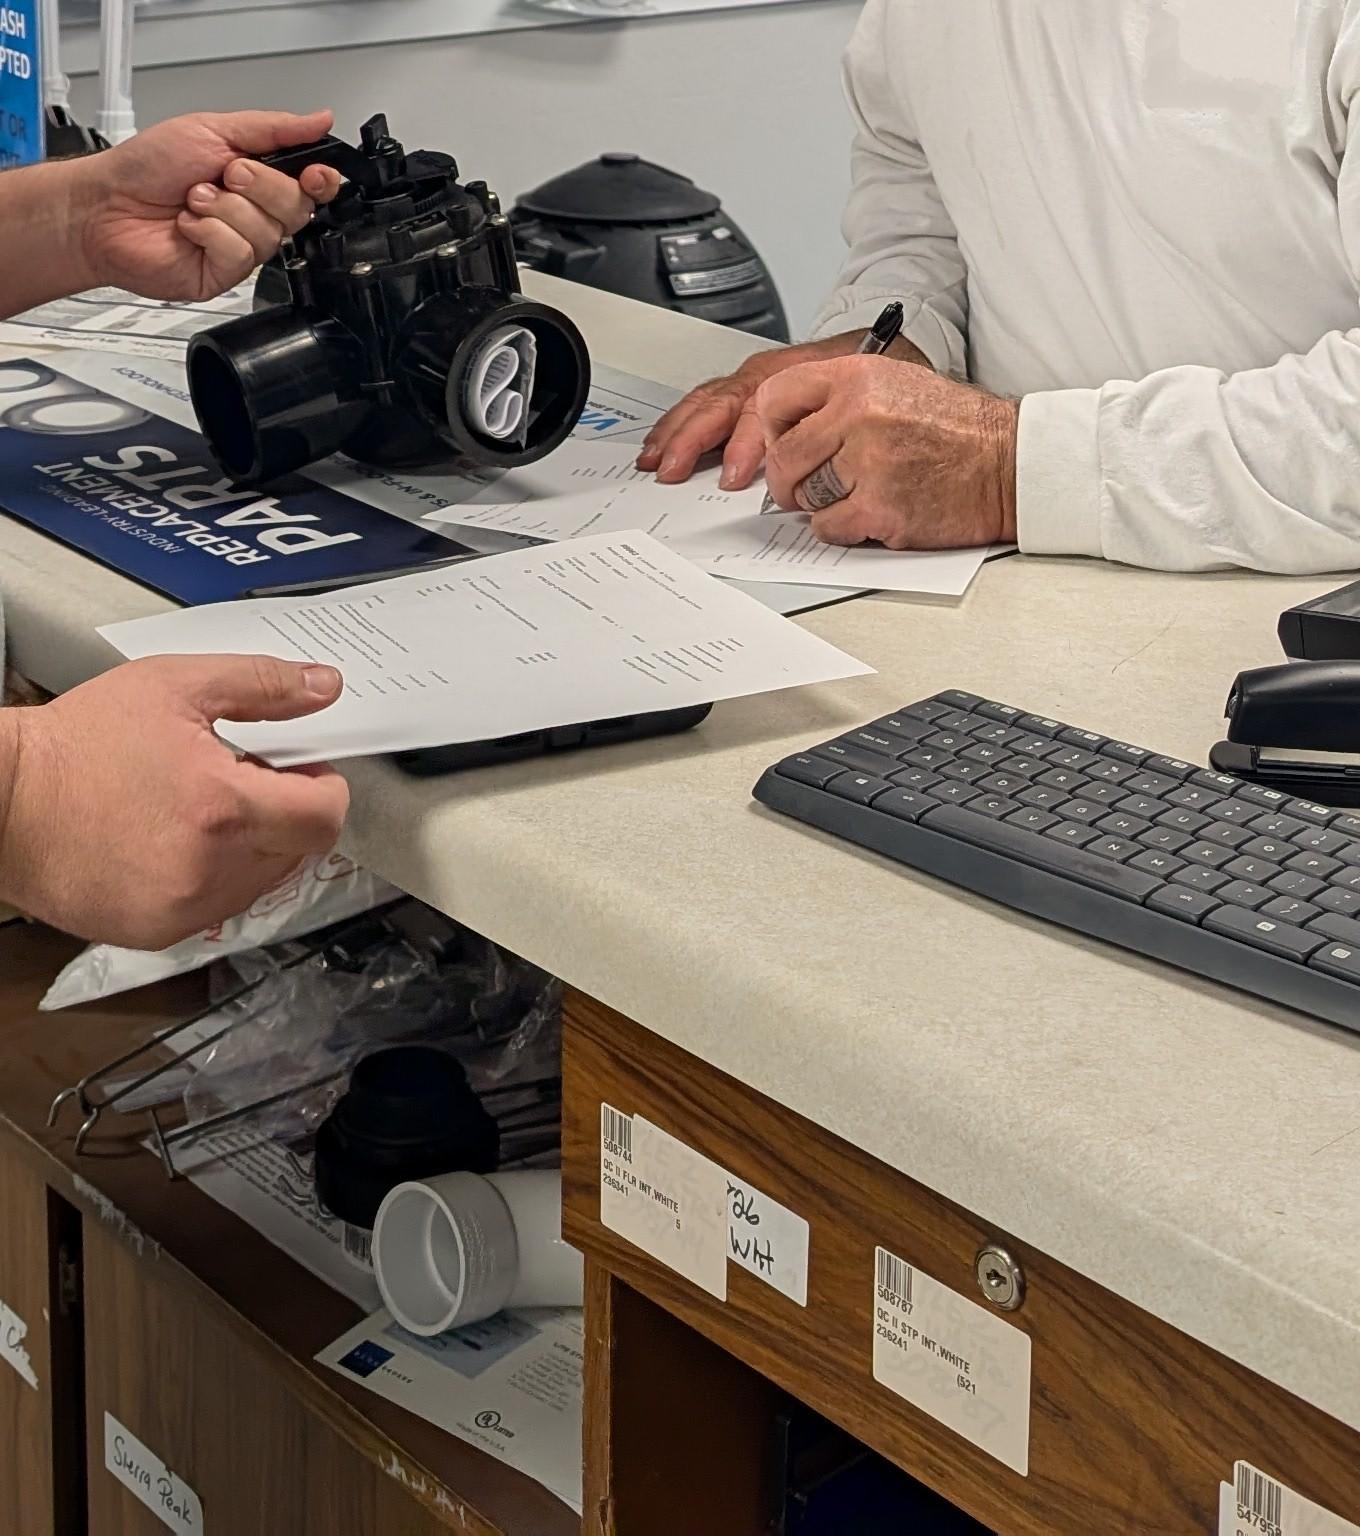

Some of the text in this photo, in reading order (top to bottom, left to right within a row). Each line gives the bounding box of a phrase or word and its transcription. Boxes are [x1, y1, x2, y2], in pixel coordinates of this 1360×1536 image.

[32, 462, 271, 567] REPLACEMENT
[82, 445, 363, 556] PARTS
[888, 719, 901, 728] tab
[603, 1137, 633, 1165] 508744
[603, 1157, 613, 1172] QC
[603, 1172, 630, 1197] 236341
[676, 1218, 682, 1231] 5
[877, 1284, 914, 1315] 508787
[875, 1323, 908, 1353] 236241
[876, 1307, 889, 1325] QC
[900, 1320, 919, 1342] STP
[157, 1475, 193, 1526] Peak
[1236, 1503, 1283, 1536] 547958
